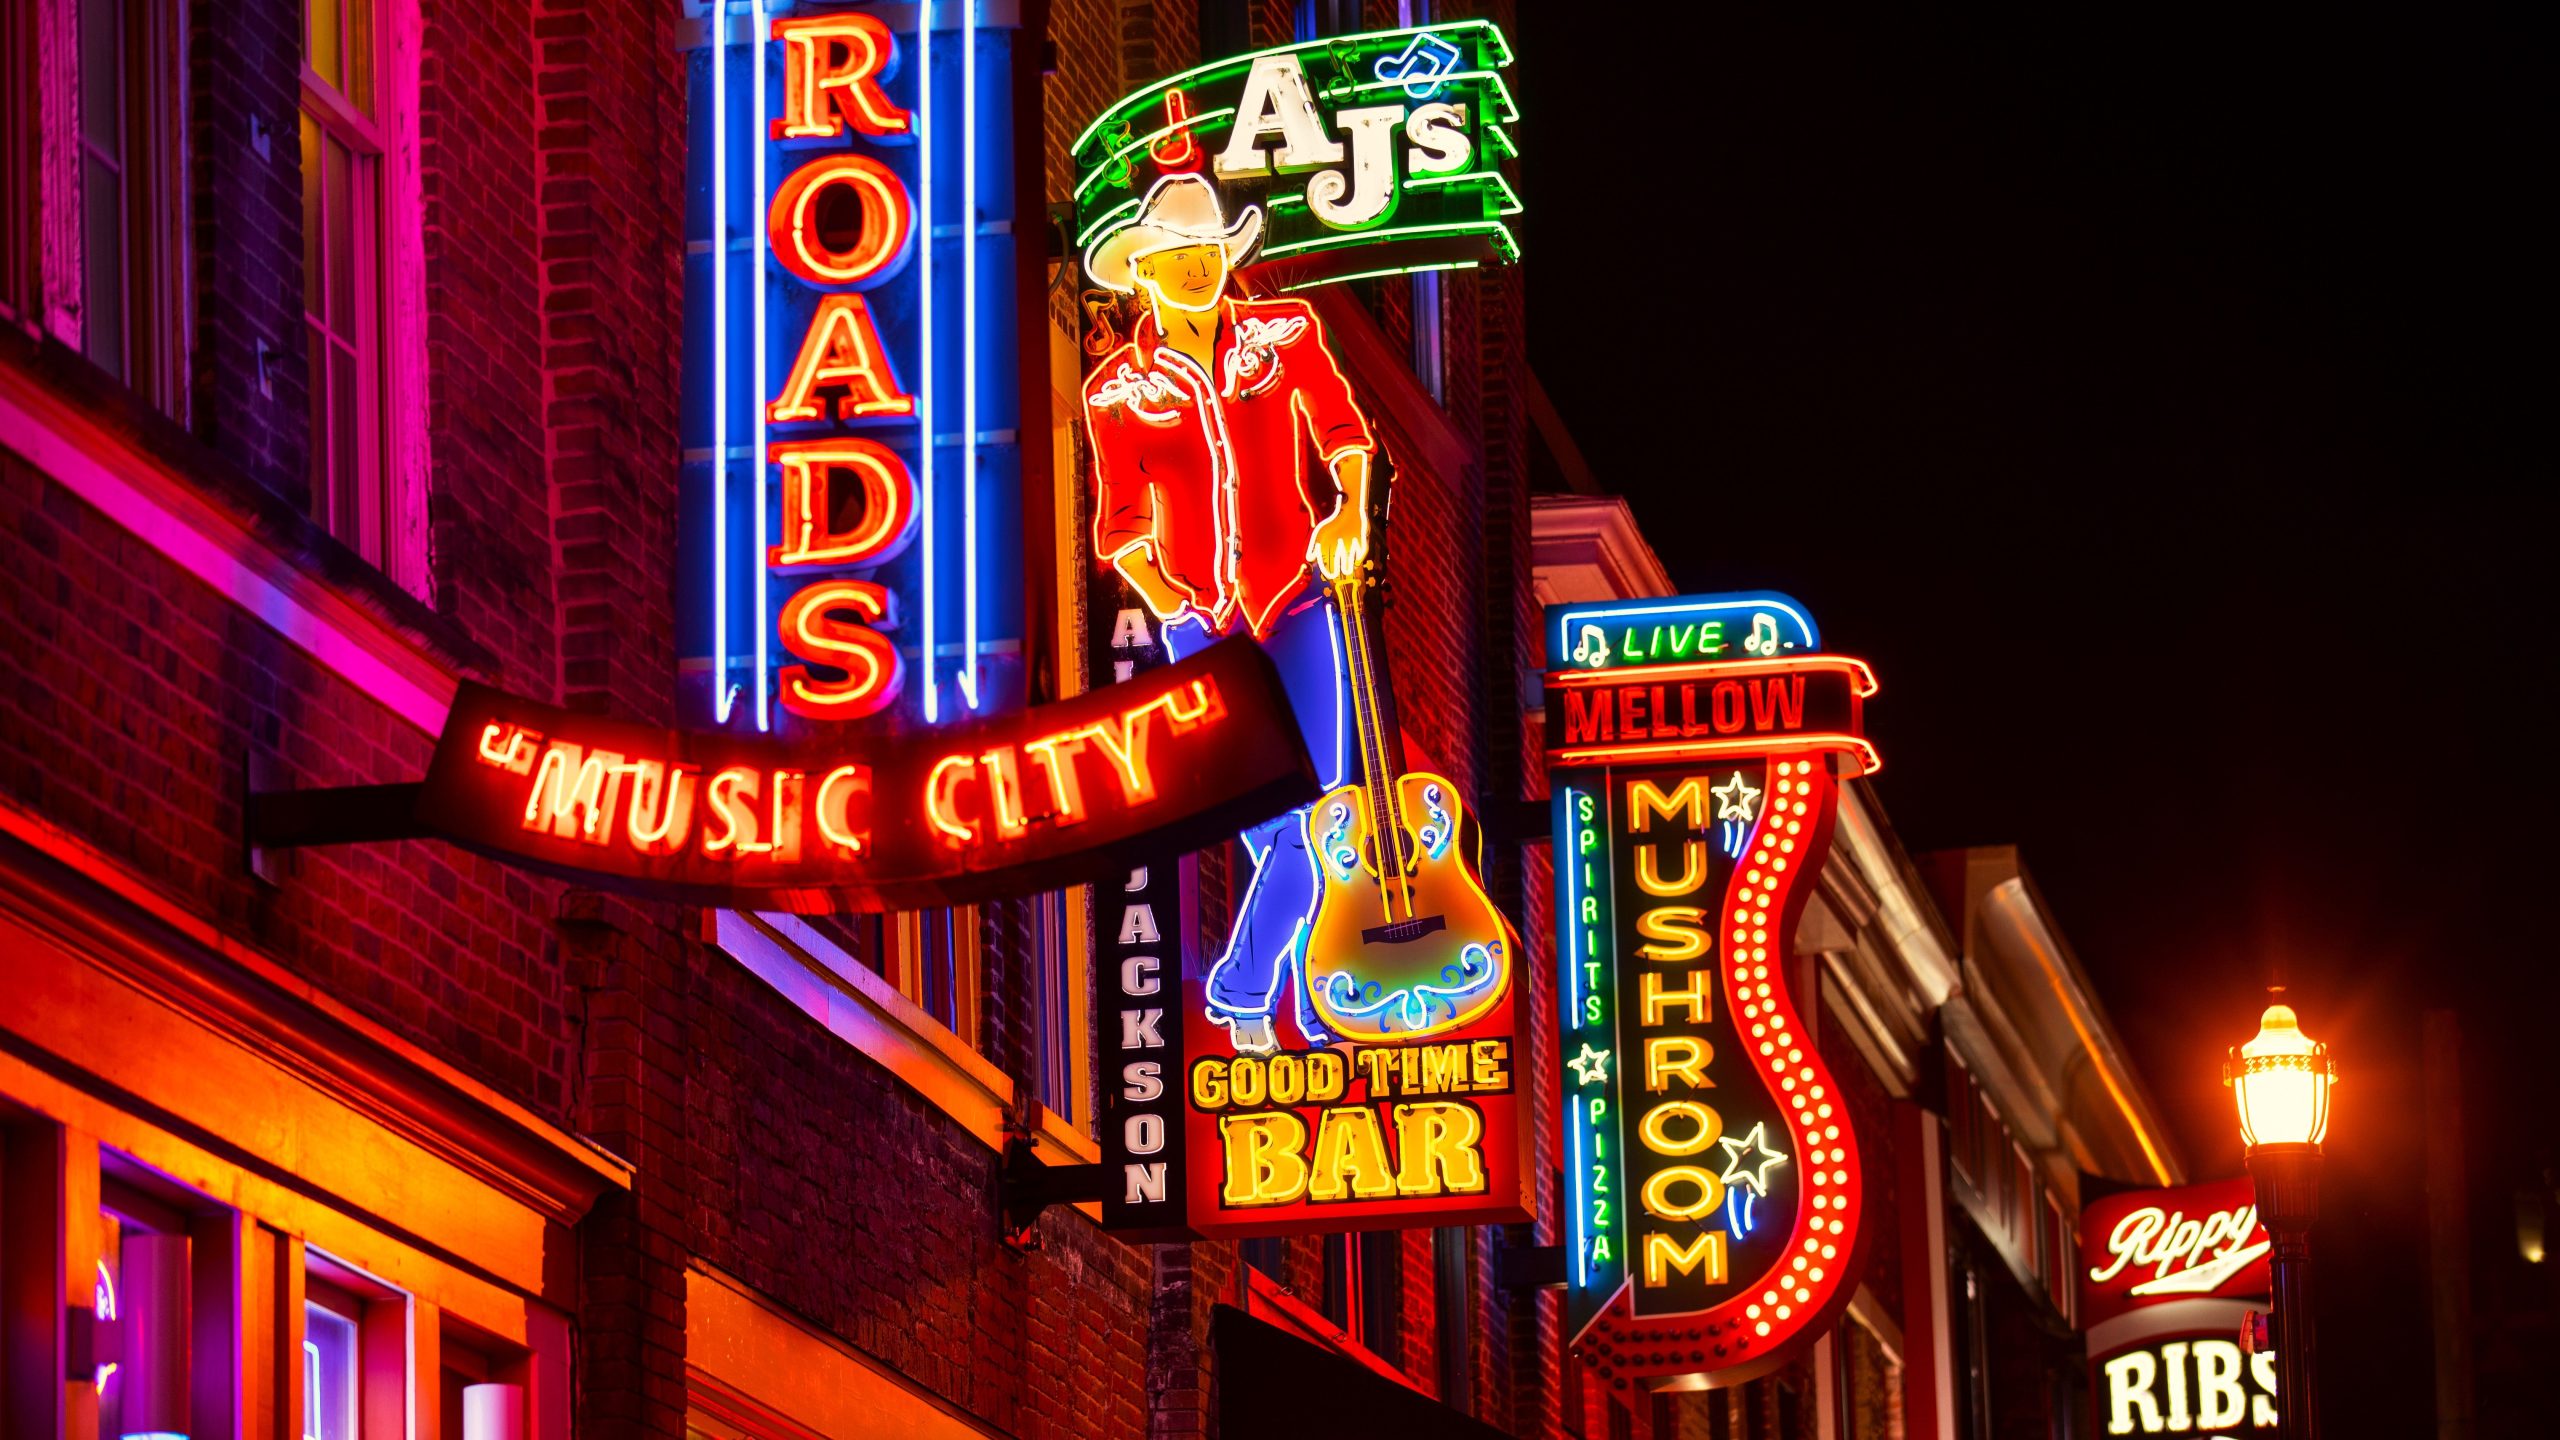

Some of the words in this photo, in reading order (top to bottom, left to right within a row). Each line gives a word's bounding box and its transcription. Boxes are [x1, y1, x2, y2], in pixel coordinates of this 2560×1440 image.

[767, 13, 917, 721] ROADS
[1622, 622, 1725, 661] LIVE
[1564, 675, 1806, 743] MELLOW
[1578, 795, 1604, 1026] SPIRITS
[1193, 1052, 1344, 1108] GOOD
[1357, 1040, 1509, 1096] TIME
[1627, 776, 1728, 1289] MUSHROOM
[1220, 1102, 1485, 1206] BAR
[1589, 1097, 1612, 1261] PIZZA
[2090, 1204, 2266, 1283] Rippy
